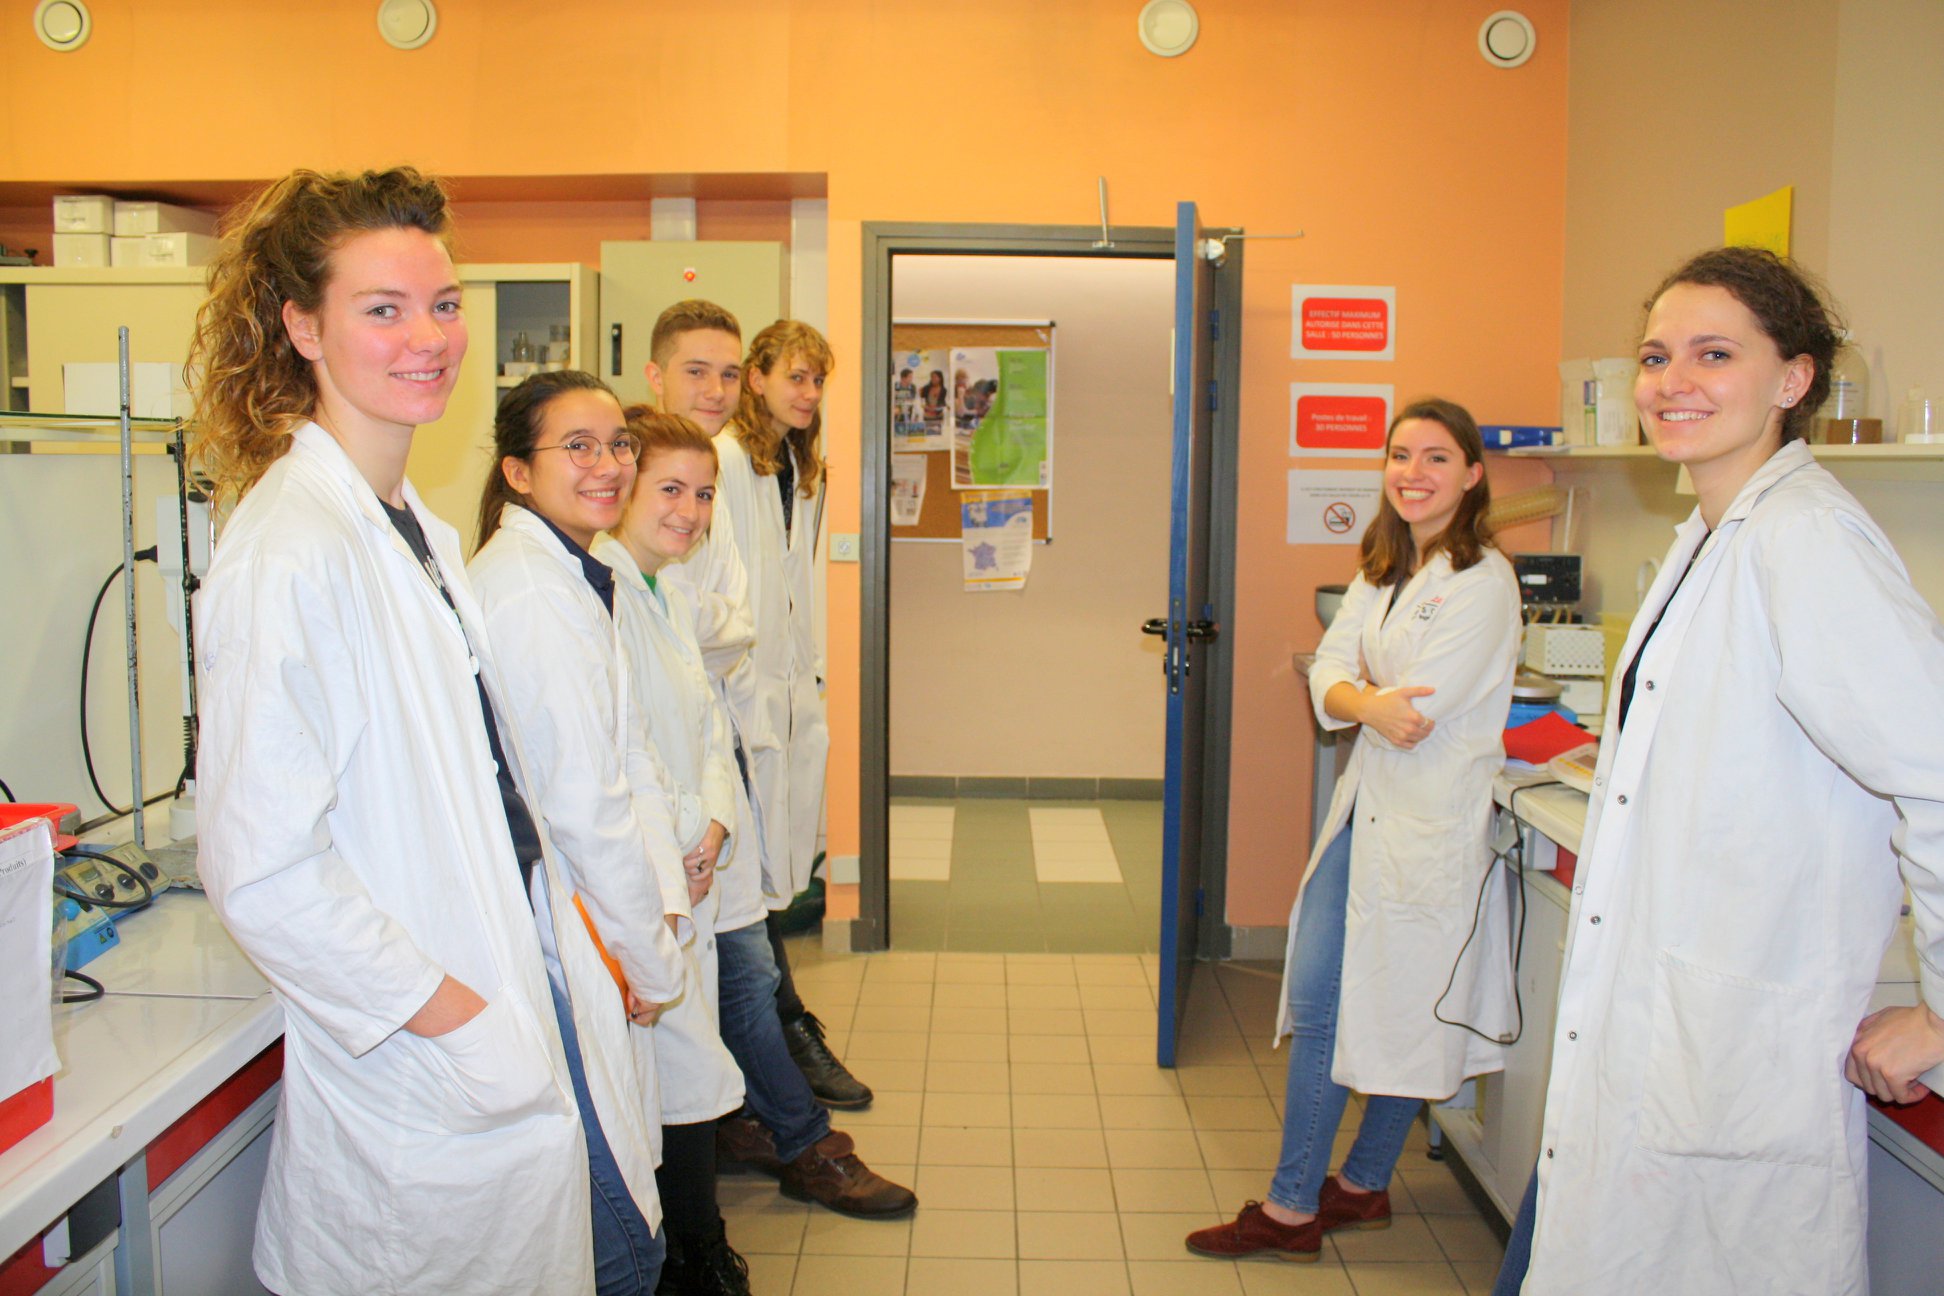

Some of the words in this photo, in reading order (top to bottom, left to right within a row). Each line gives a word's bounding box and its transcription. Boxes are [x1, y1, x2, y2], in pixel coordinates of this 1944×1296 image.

[1341, 321, 1361, 329] DANS
[1362, 321, 1384, 330] CETTE
[1305, 330, 1326, 338] SALLE
[1342, 331, 1384, 340] PERSONNES
[1326, 424, 1368, 432] PERSONNES
[0, 857, 27, 876] roduits)
